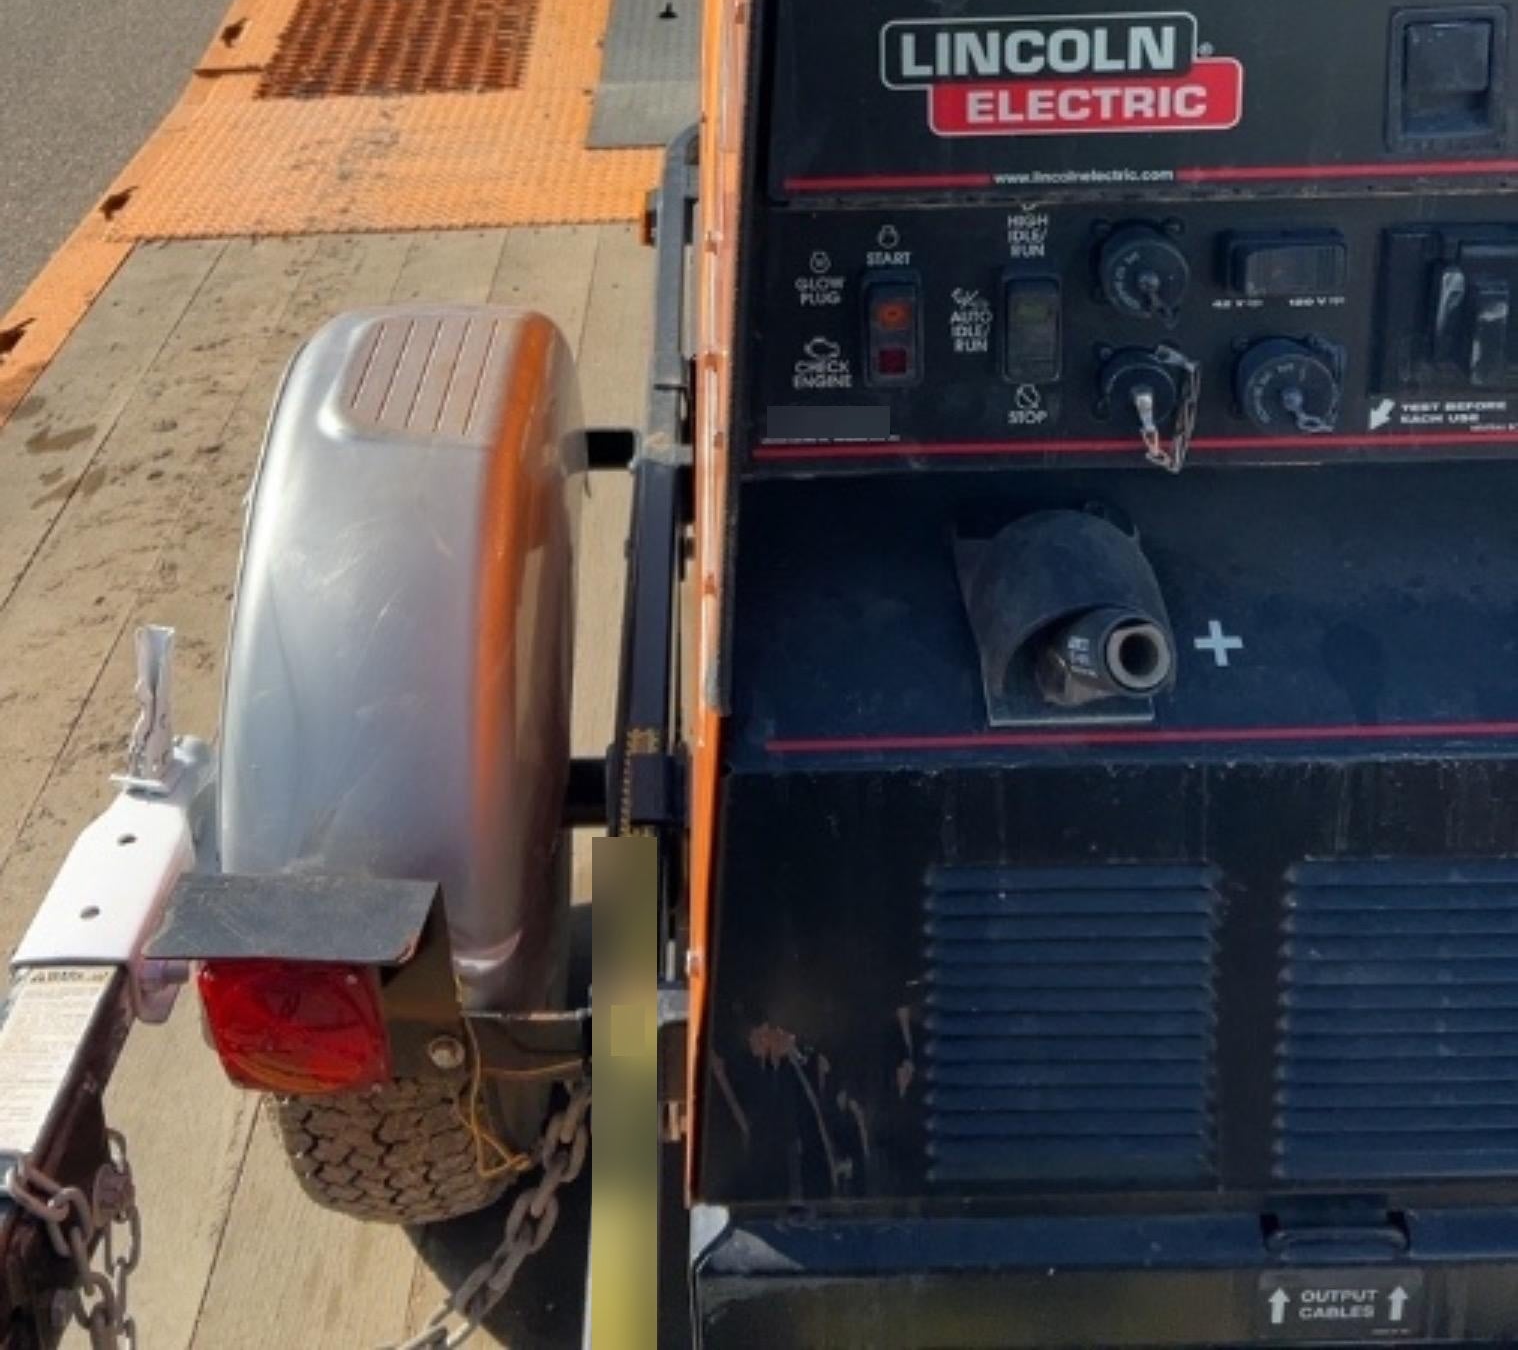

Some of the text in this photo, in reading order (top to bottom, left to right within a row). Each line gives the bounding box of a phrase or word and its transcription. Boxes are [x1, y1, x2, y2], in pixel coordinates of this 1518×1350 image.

[901, 25, 1176, 76] LINCOLN
[966, 85, 1207, 123] ELECTRIC
[993, 169, 1174, 184] www.lincolnelectric.com
[866, 250, 911, 266] START
[795, 276, 845, 292] GLOW
[800, 291, 841, 306] PLUG
[950, 310, 993, 324] AUTO
[794, 359, 850, 375] CHECK
[793, 374, 853, 390] ENGINE
[1401, 401, 1507, 413] TEST BEFORE
[1008, 410, 1048, 425] STOP
[1400, 413, 1480, 425] EACH USE
[1301, 1289, 1379, 1304] OUTPUT
[1299, 1305, 1375, 1320] CABLES
